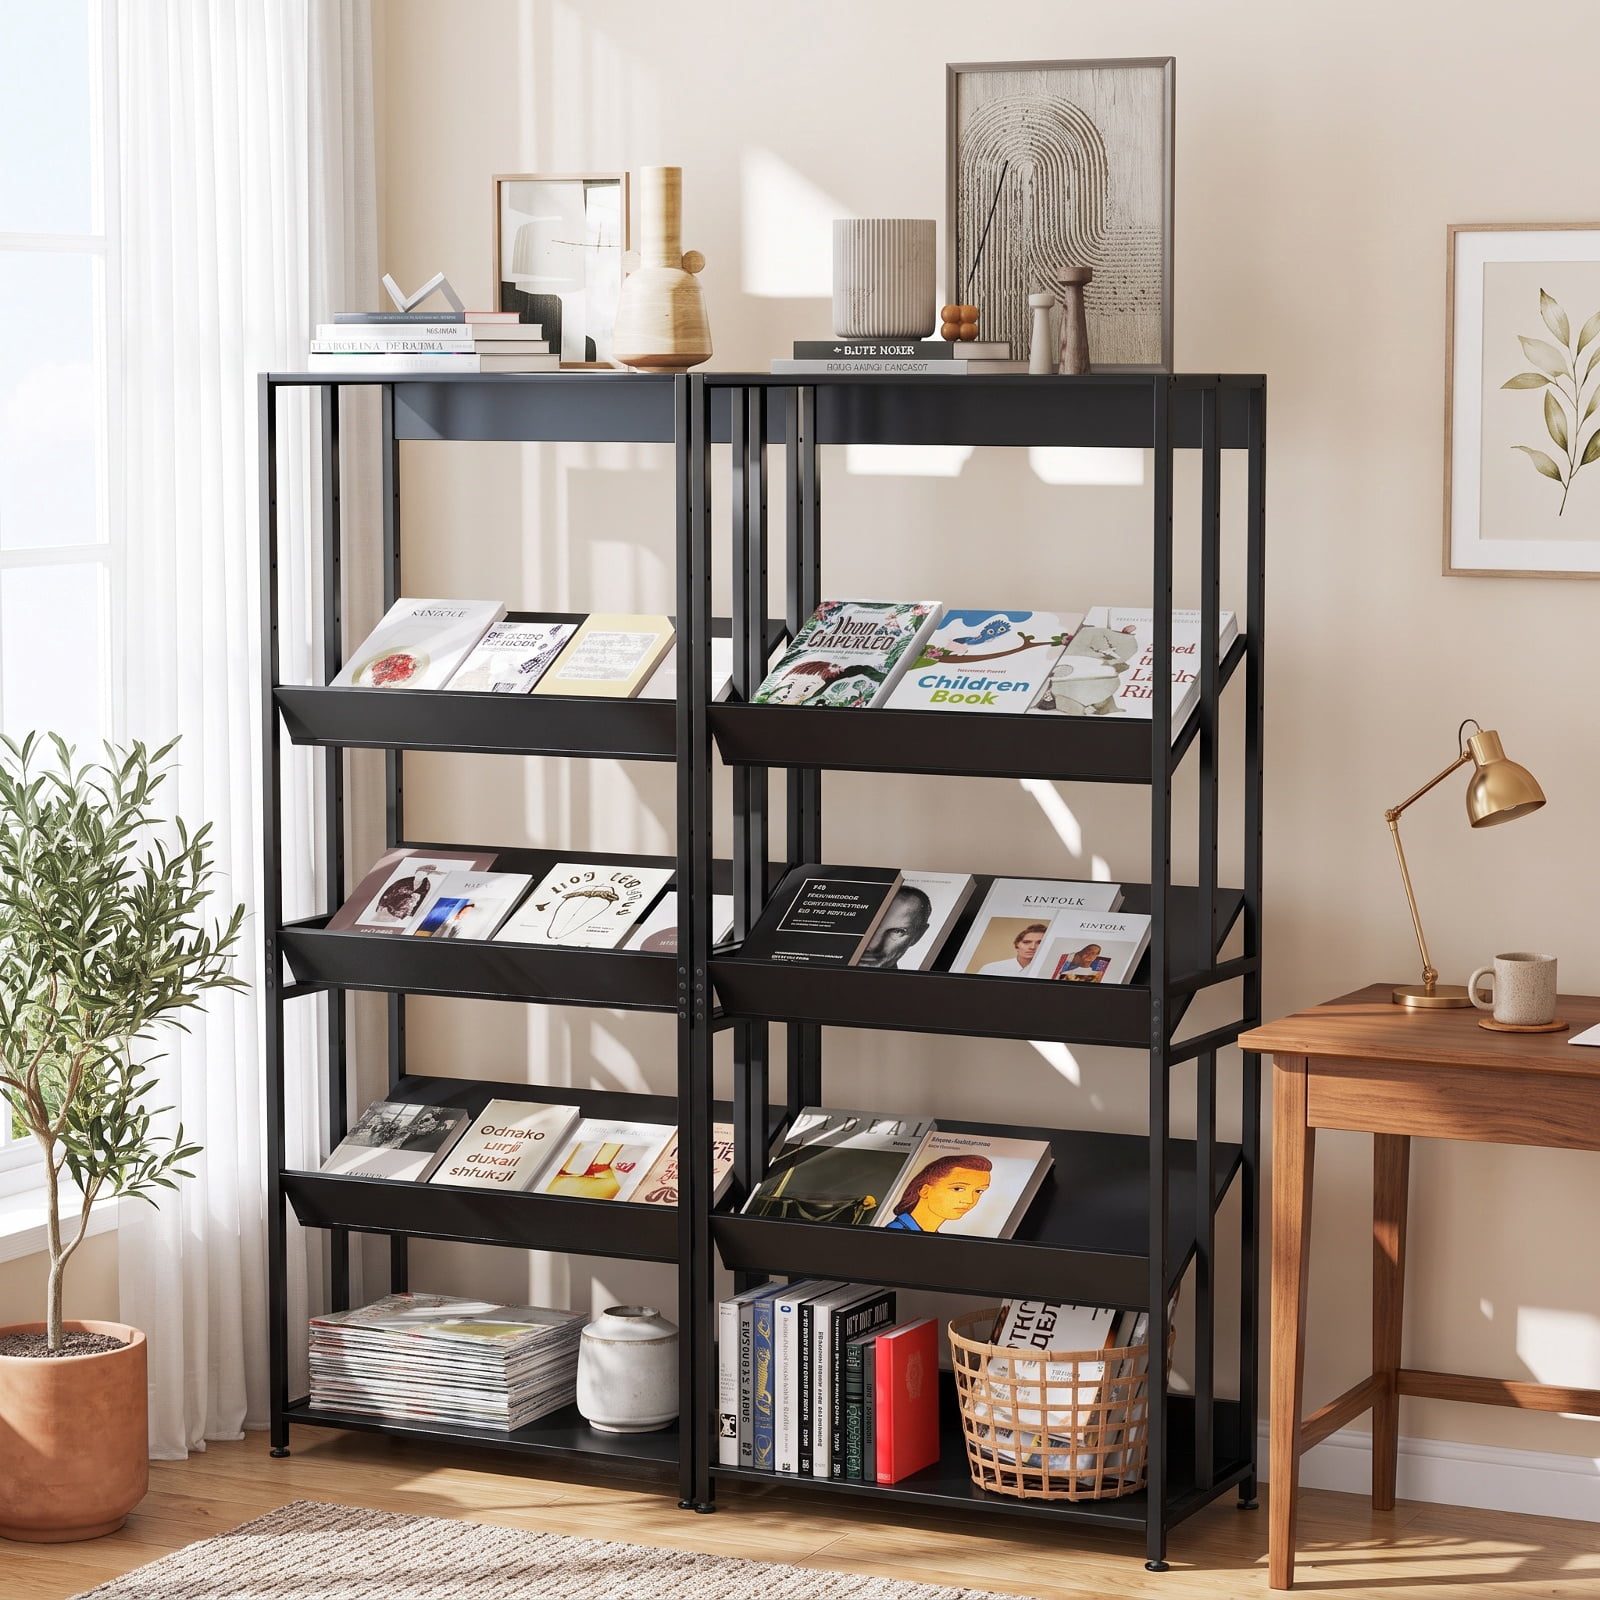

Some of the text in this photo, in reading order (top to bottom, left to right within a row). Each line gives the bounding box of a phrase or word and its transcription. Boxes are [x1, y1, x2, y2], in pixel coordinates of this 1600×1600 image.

[917, 675, 1030, 692] Children
[929, 689, 999, 705] Book
[1023, 895, 1087, 907] KINTOLK
[480, 1125, 545, 1141] Odnako
